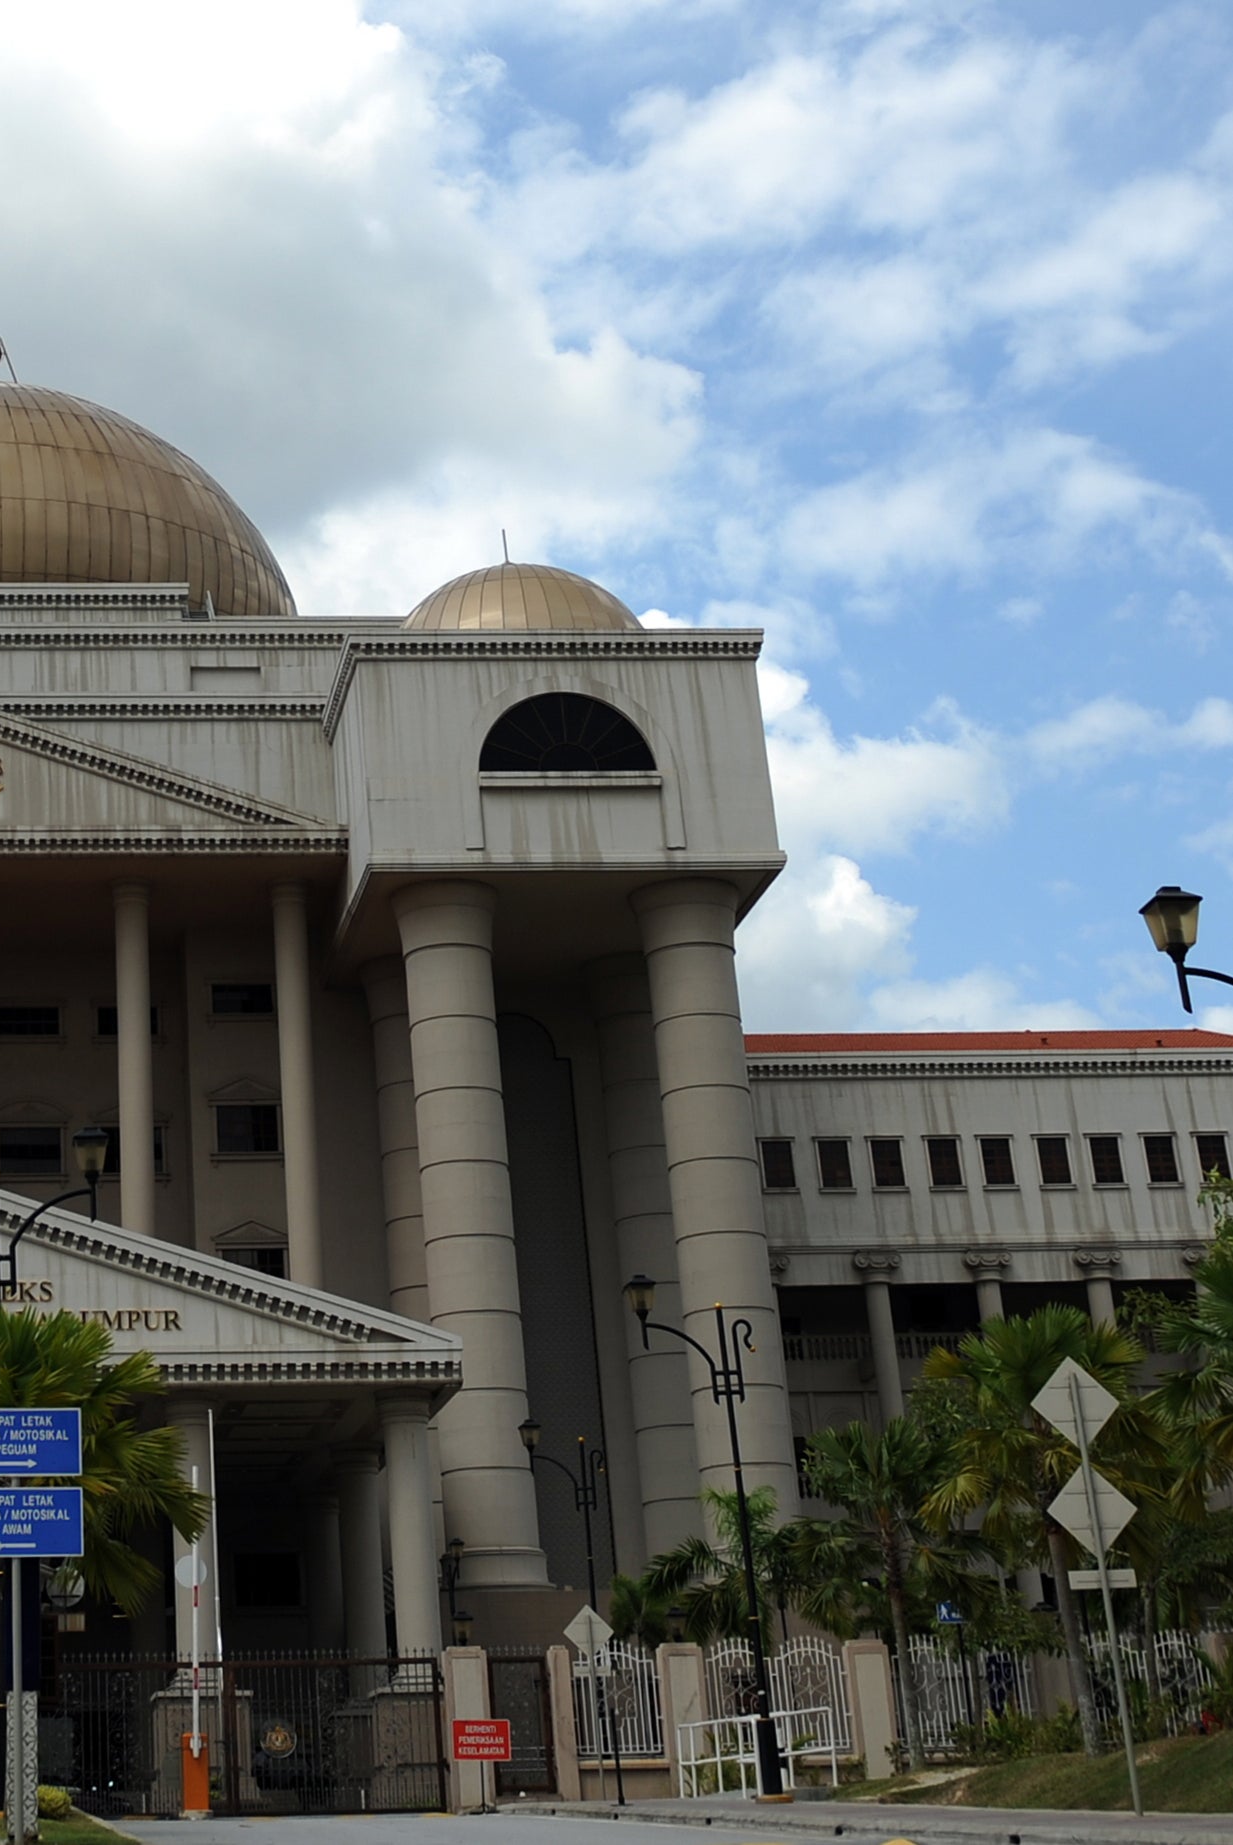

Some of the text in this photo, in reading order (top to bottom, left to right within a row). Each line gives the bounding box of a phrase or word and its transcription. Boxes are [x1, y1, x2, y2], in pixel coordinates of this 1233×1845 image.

[21, 1415, 53, 1427] LETAK
[10, 1429, 69, 1441] MOTOSIKAL
[22, 1495, 54, 1506] LETAK
[11, 1509, 70, 1520] MOTOSIKAL
[2, 1523, 32, 1534] AWAM
